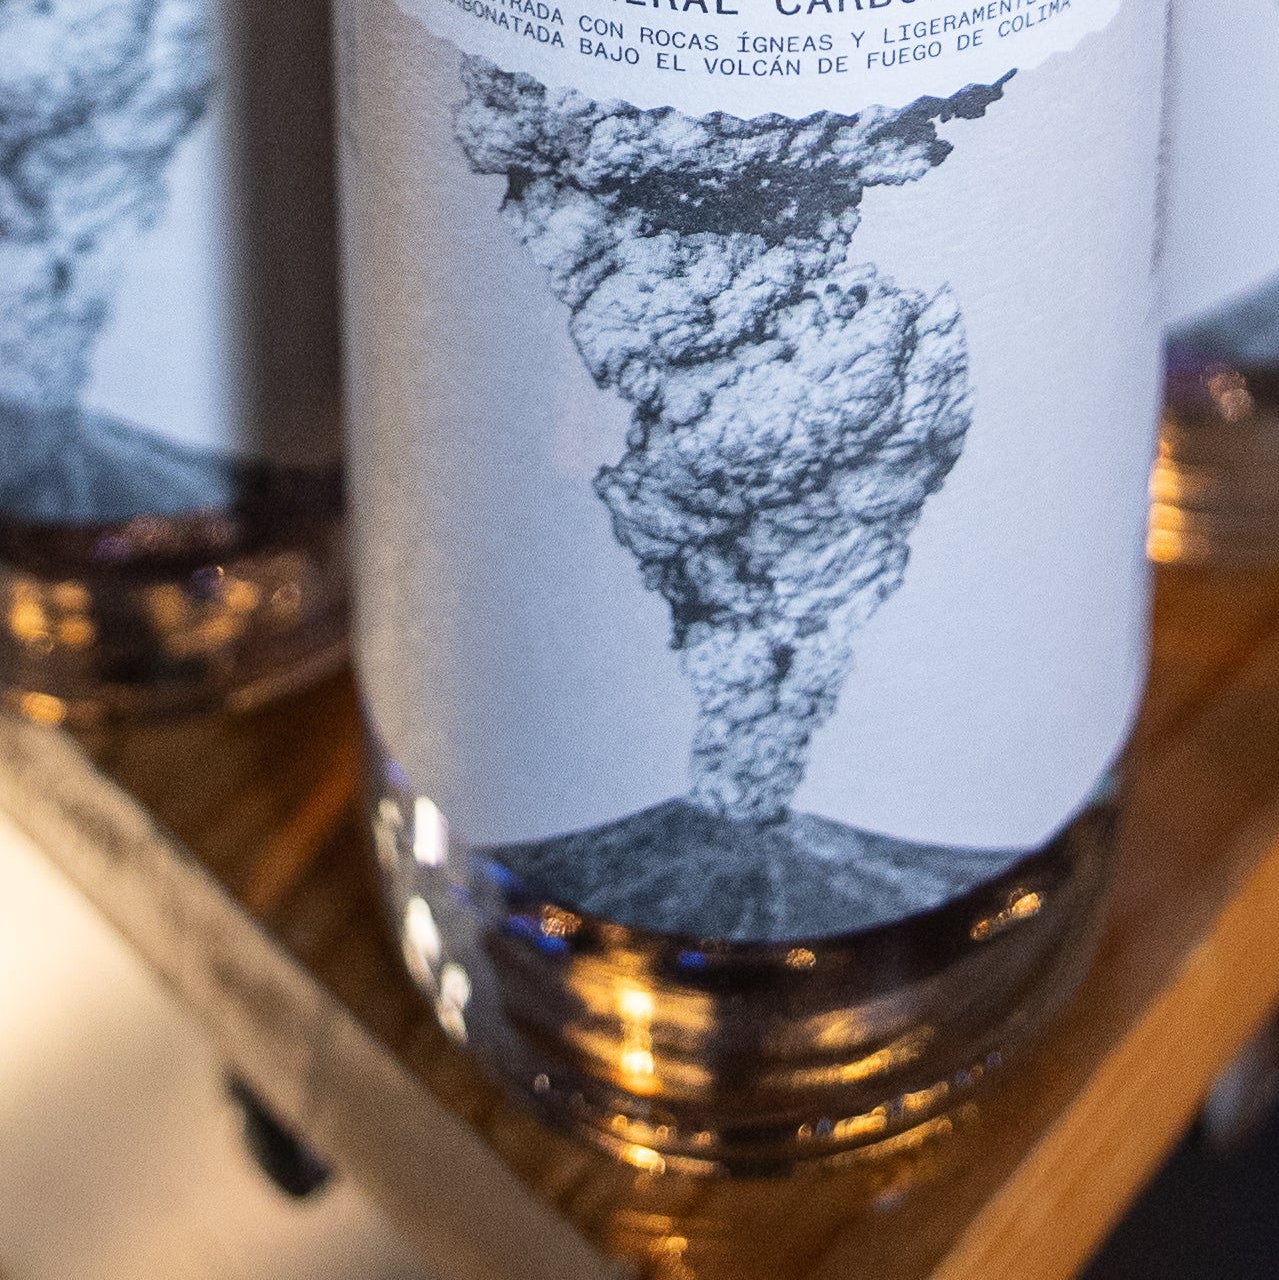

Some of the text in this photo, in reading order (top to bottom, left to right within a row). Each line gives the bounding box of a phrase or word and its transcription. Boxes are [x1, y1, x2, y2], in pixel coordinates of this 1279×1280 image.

[578, 14, 624, 40] CON
[639, 26, 720, 52] ROCAS
[736, 31, 833, 54] ÍGNEAS
[850, 30, 865, 49] Y
[579, 38, 640, 66] BAJO
[656, 52, 686, 72] EL
[704, 55, 801, 77] VOLCÁN
[817, 56, 849, 75] DE
[866, 41, 943, 70] FUEGO
[956, 28, 984, 52] DE
